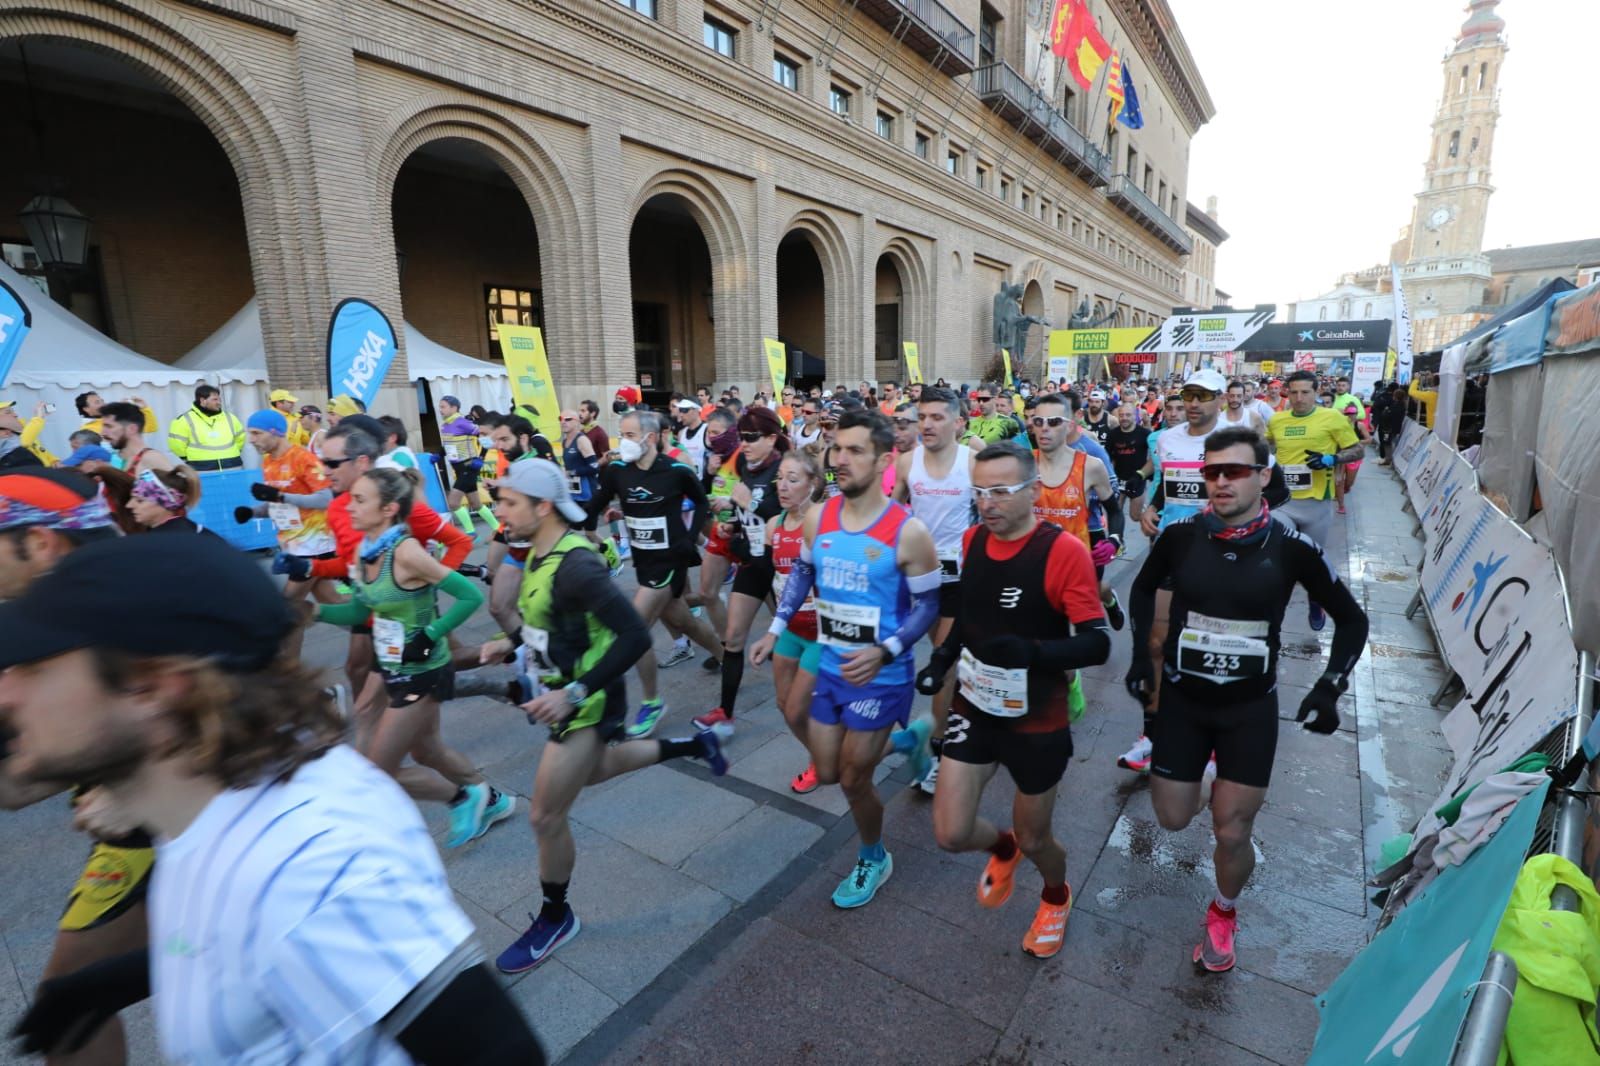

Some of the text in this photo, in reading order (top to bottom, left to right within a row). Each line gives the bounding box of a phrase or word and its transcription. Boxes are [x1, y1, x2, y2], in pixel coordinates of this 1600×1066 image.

[1075, 333, 1108, 341] MANN
[1316, 330, 1365, 339] CaixaBank
[1074, 341, 1107, 349] FILTER
[343, 330, 387, 400] HOKA
[1176, 482, 1199, 493] 270
[822, 567, 869, 593] RUSA
[1203, 652, 1241, 671] 233
